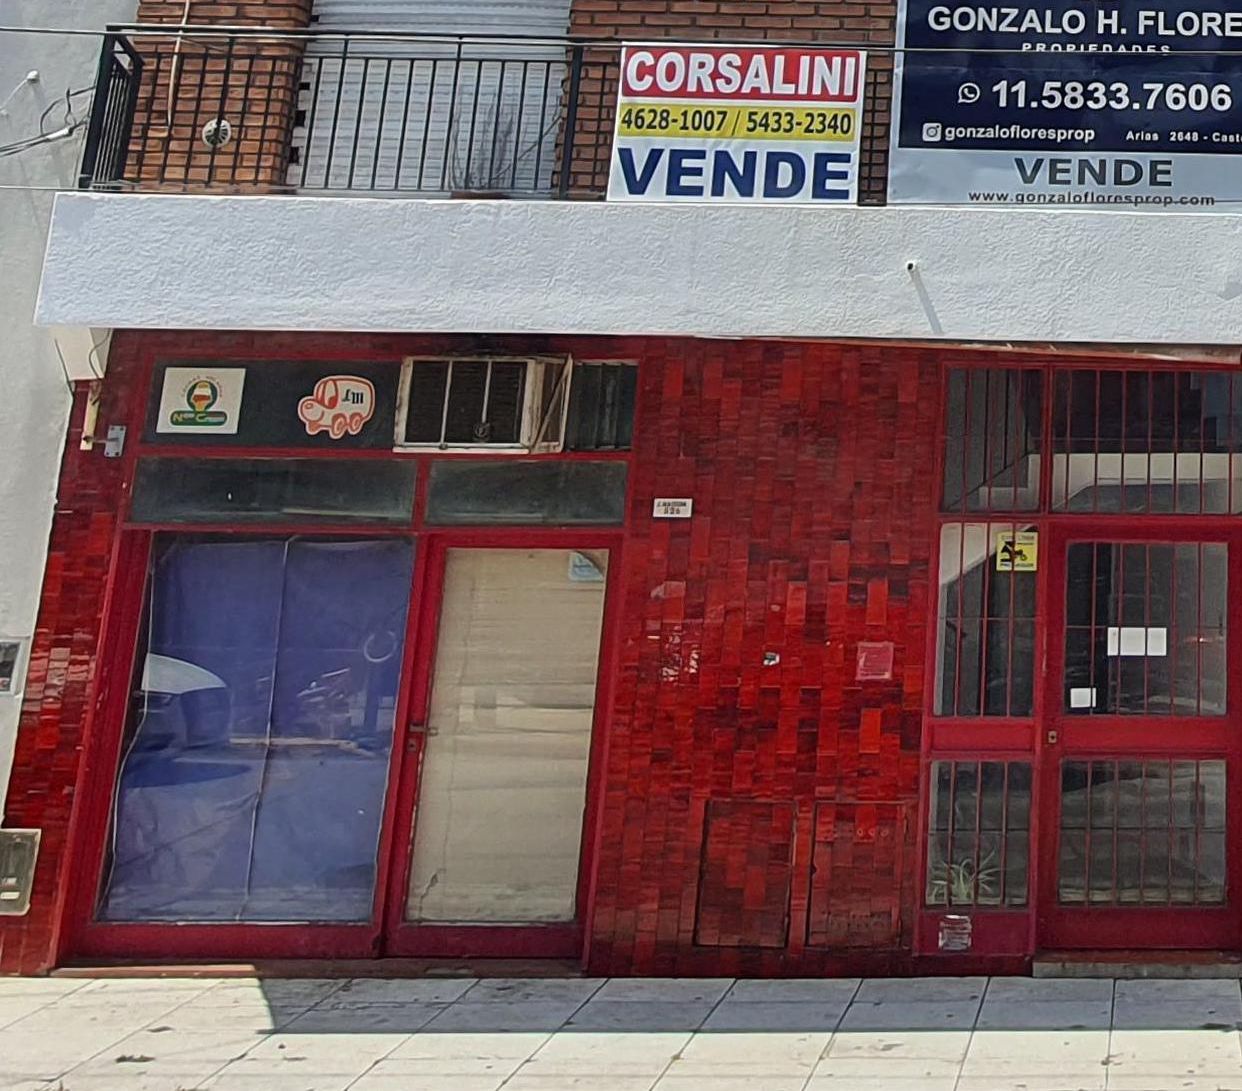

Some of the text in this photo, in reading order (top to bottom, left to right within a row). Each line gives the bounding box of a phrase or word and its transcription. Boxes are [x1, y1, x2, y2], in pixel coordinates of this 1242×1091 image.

[928, 6, 1086, 33] GONZALO
[1097, 10, 1127, 34] H.
[1022, 42, 1170, 56] PROPIEDADES
[626, 51, 856, 96] CORSALINI
[991, 80, 1233, 110] 11.5833.7606
[621, 108, 728, 132] 4628-1007
[746, 112, 850, 135] 5433-2340
[945, 124, 1095, 143] gonzalofloresprop
[1126, 130, 1159, 141] Arias
[617, 147, 852, 199] VENDE
[1014, 158, 1173, 187] VENDE
[968, 191, 1215, 207] www.gonzalofloresprop.com
